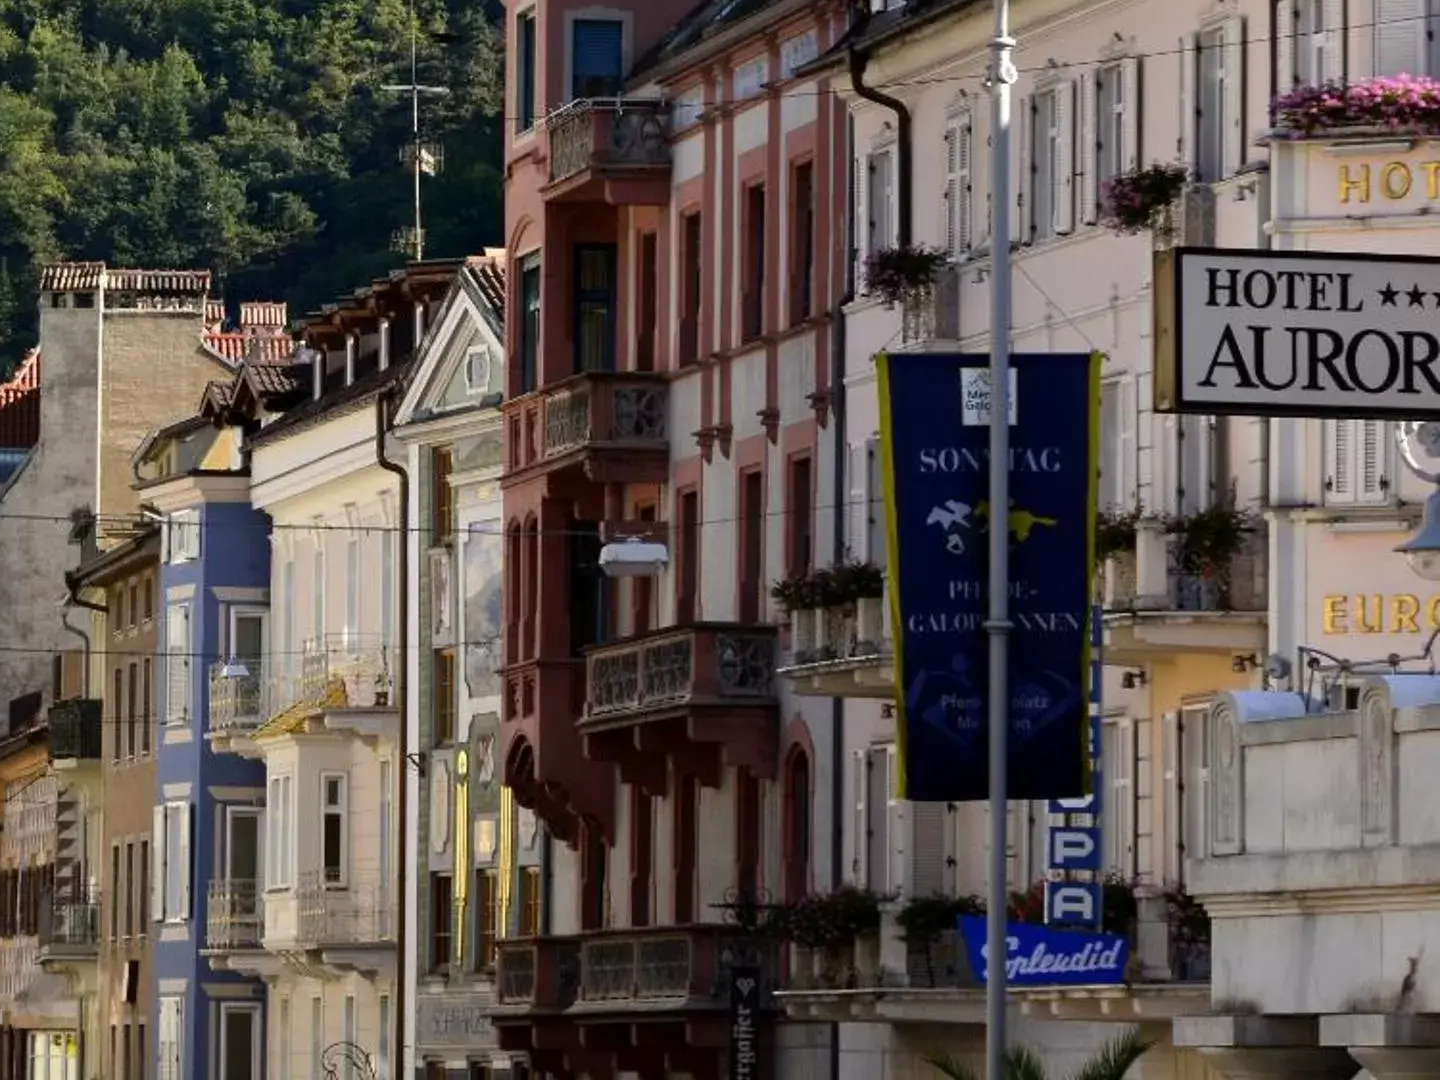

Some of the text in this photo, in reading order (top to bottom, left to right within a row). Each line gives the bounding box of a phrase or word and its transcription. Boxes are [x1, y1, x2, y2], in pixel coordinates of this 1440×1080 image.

[1339, 161, 1440, 203] HOT
[1204, 267, 1364, 312] HOTEL
[1196, 322, 1440, 395] AUROR
[919, 446, 1061, 473] SONTAG
